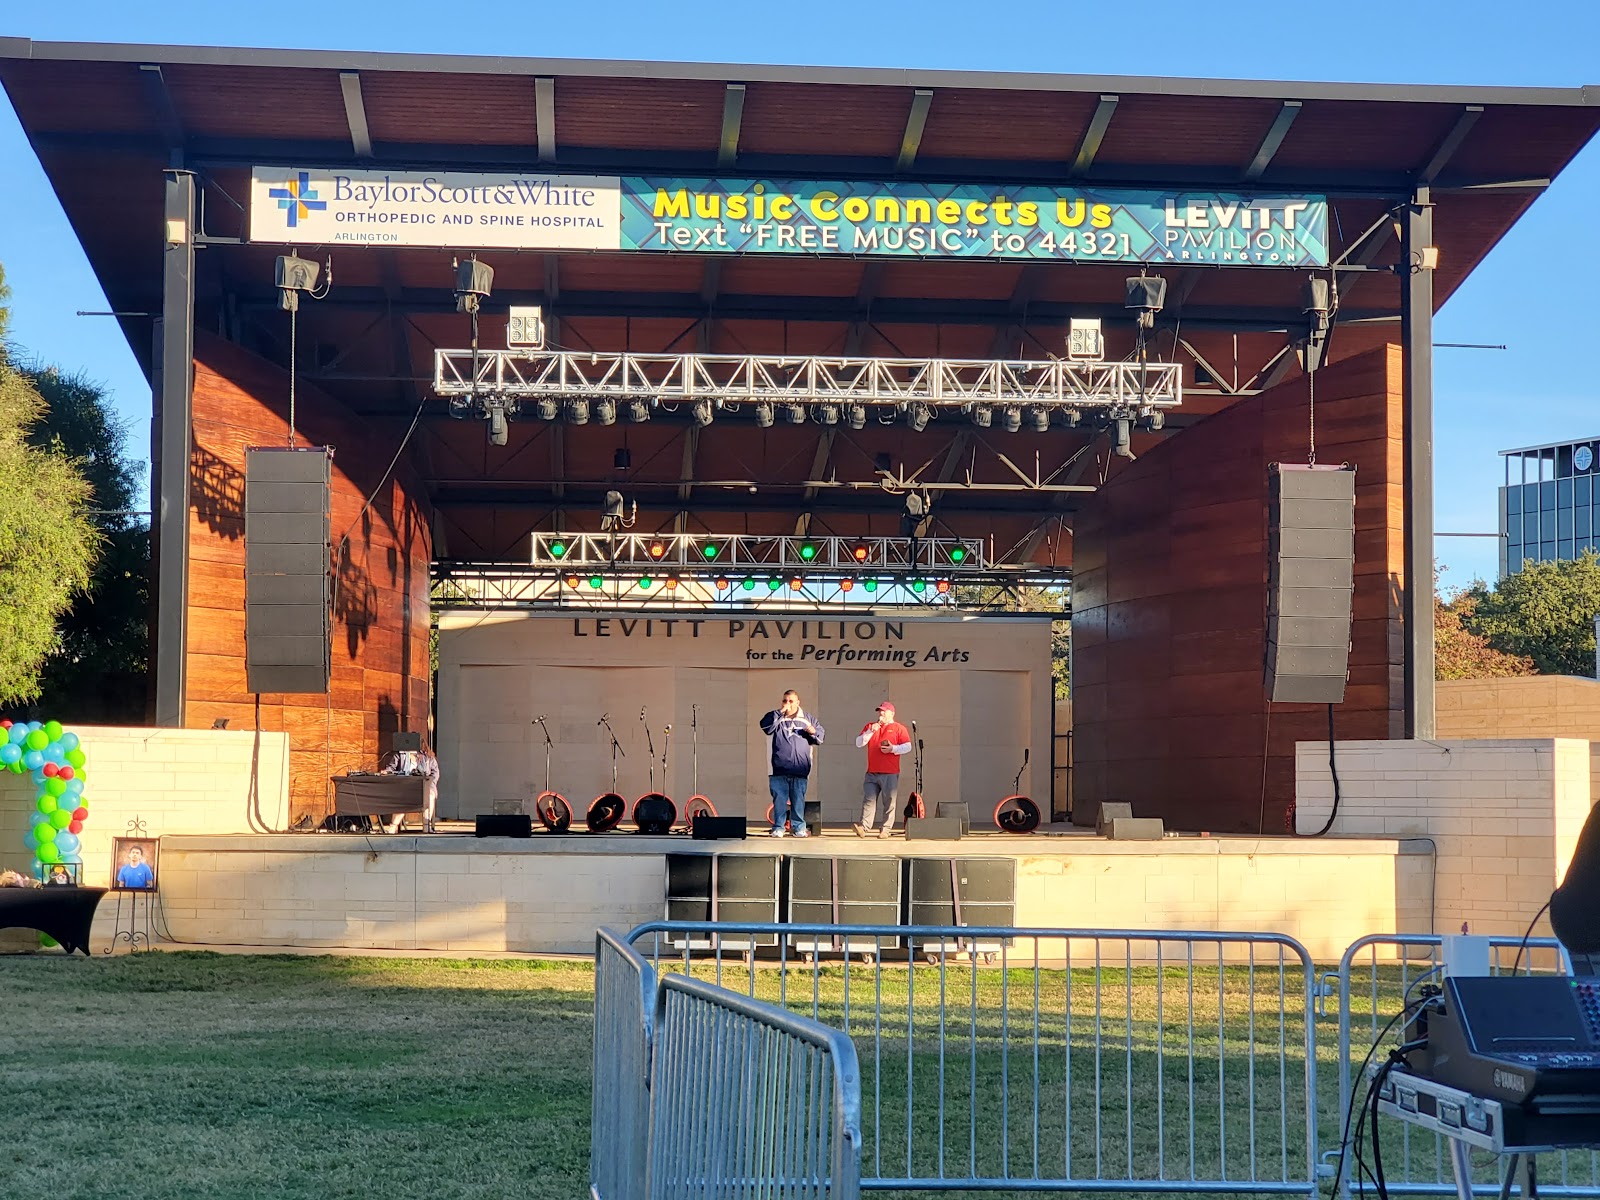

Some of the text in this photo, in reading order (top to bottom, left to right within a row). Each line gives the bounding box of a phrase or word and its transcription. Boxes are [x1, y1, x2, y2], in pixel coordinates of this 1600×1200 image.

[652, 183, 1113, 229] Music Connects Us
[1165, 198, 1310, 230] LEVITT
[335, 212, 605, 228] ORTHOPEDIC AND SPINE HOSPITAL
[334, 232, 398, 242] ARLINGTON
[653, 222, 727, 246] Text
[991, 232, 1026, 252] to
[1039, 231, 1131, 256] 44321
[1165, 230, 1296, 251] PAVILION
[1165, 251, 1296, 262] ARLINGTON
[573, 618, 905, 640] LEVITT PAVILION
[746, 644, 970, 668] for the Performing Arts
[1500, 1071, 1526, 1093] YAMAHA
